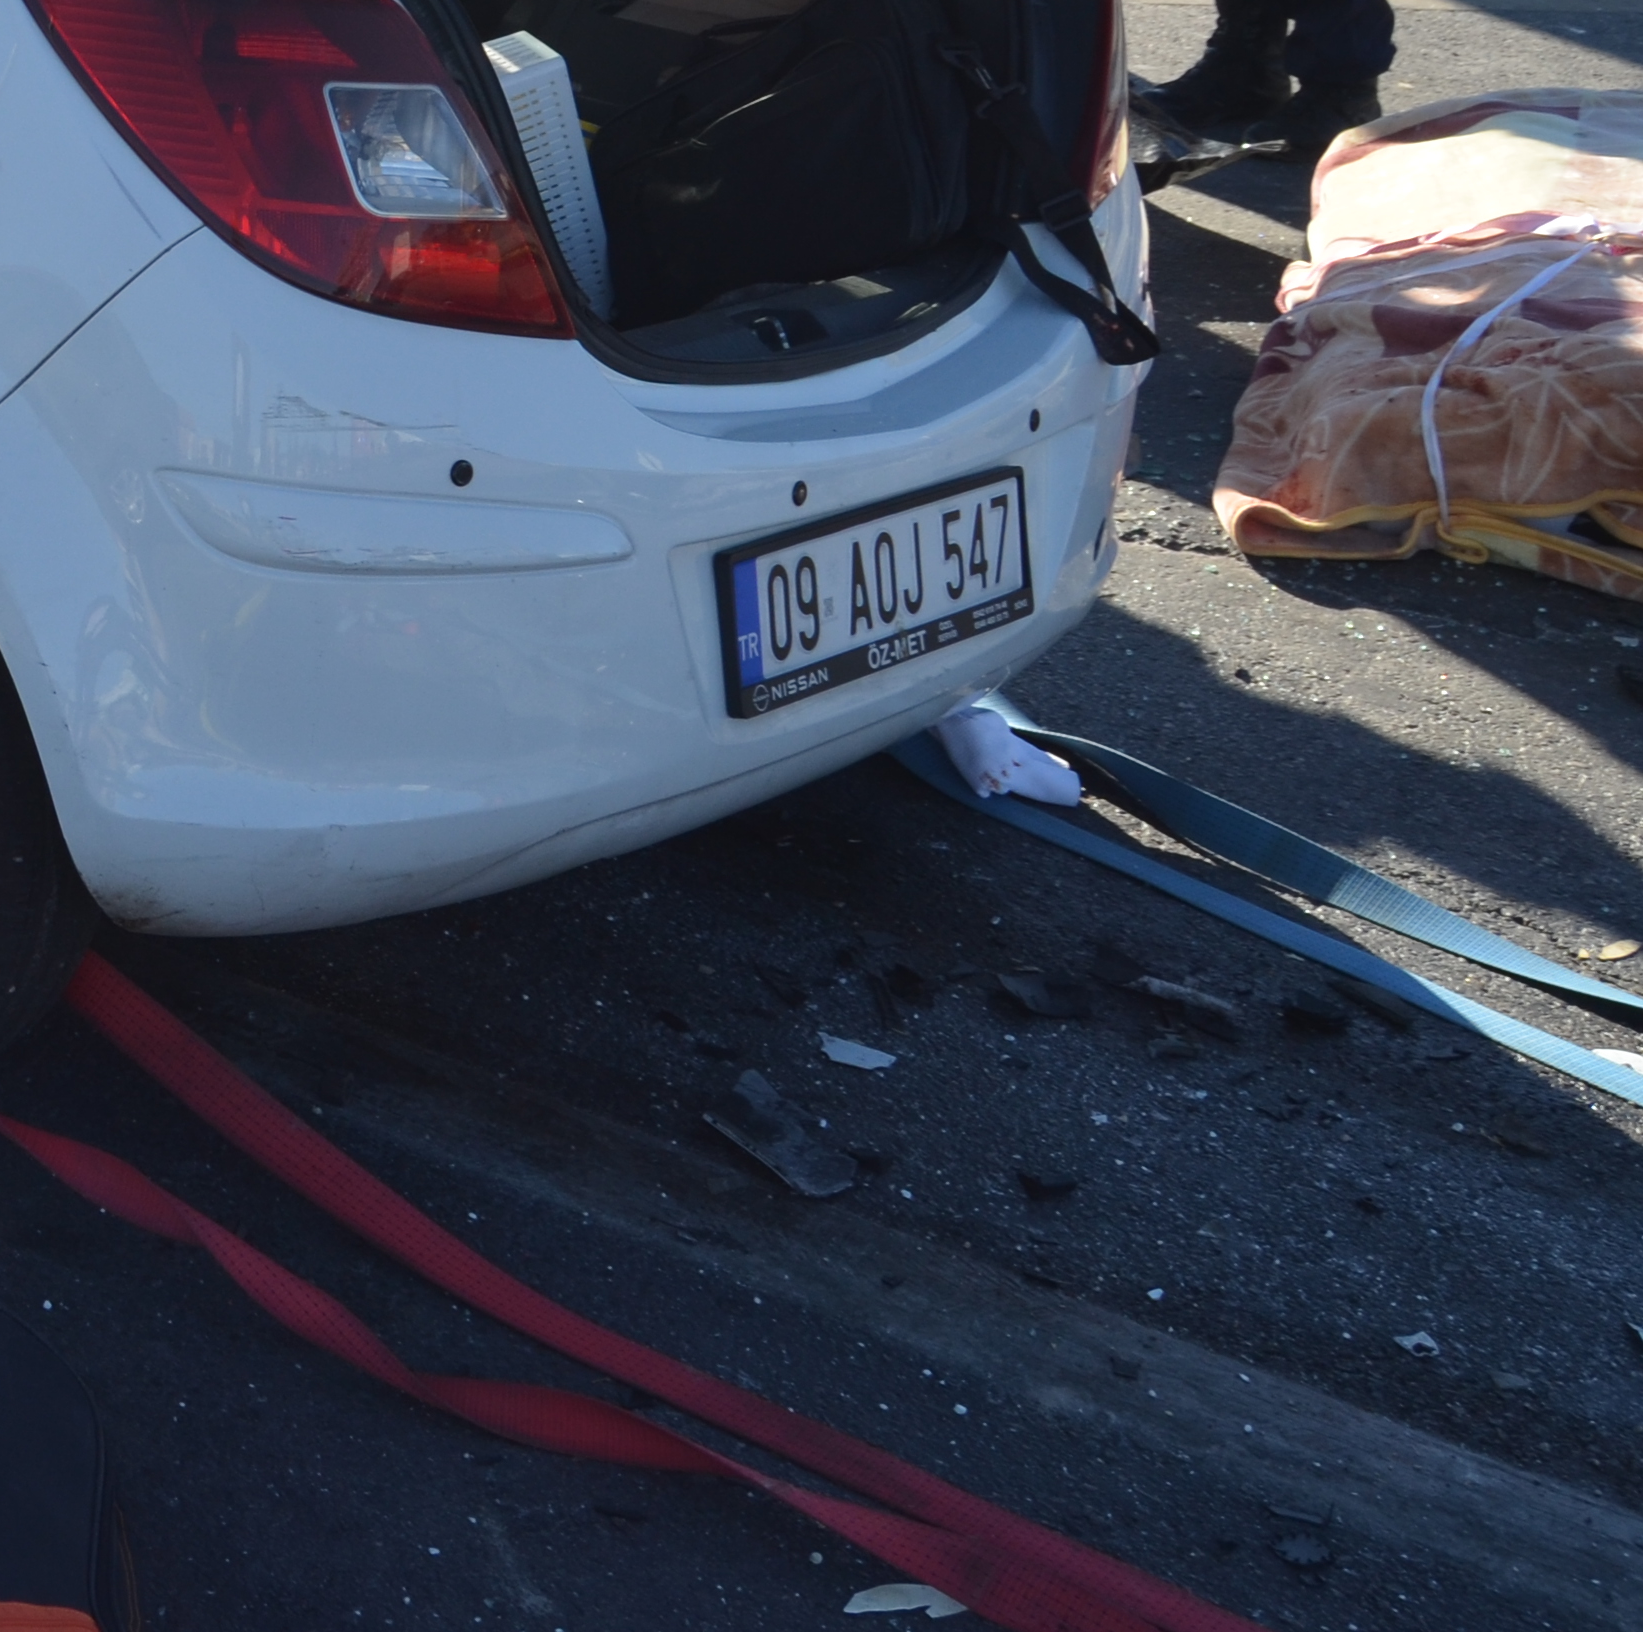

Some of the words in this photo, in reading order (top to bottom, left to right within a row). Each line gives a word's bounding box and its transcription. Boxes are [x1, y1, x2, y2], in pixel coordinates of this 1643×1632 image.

[767, 555, 820, 662] 09
[850, 521, 924, 637] AOJ
[941, 493, 1008, 601] 547
[737, 632, 759, 662] TR
[771, 667, 830, 701] NISSAN
